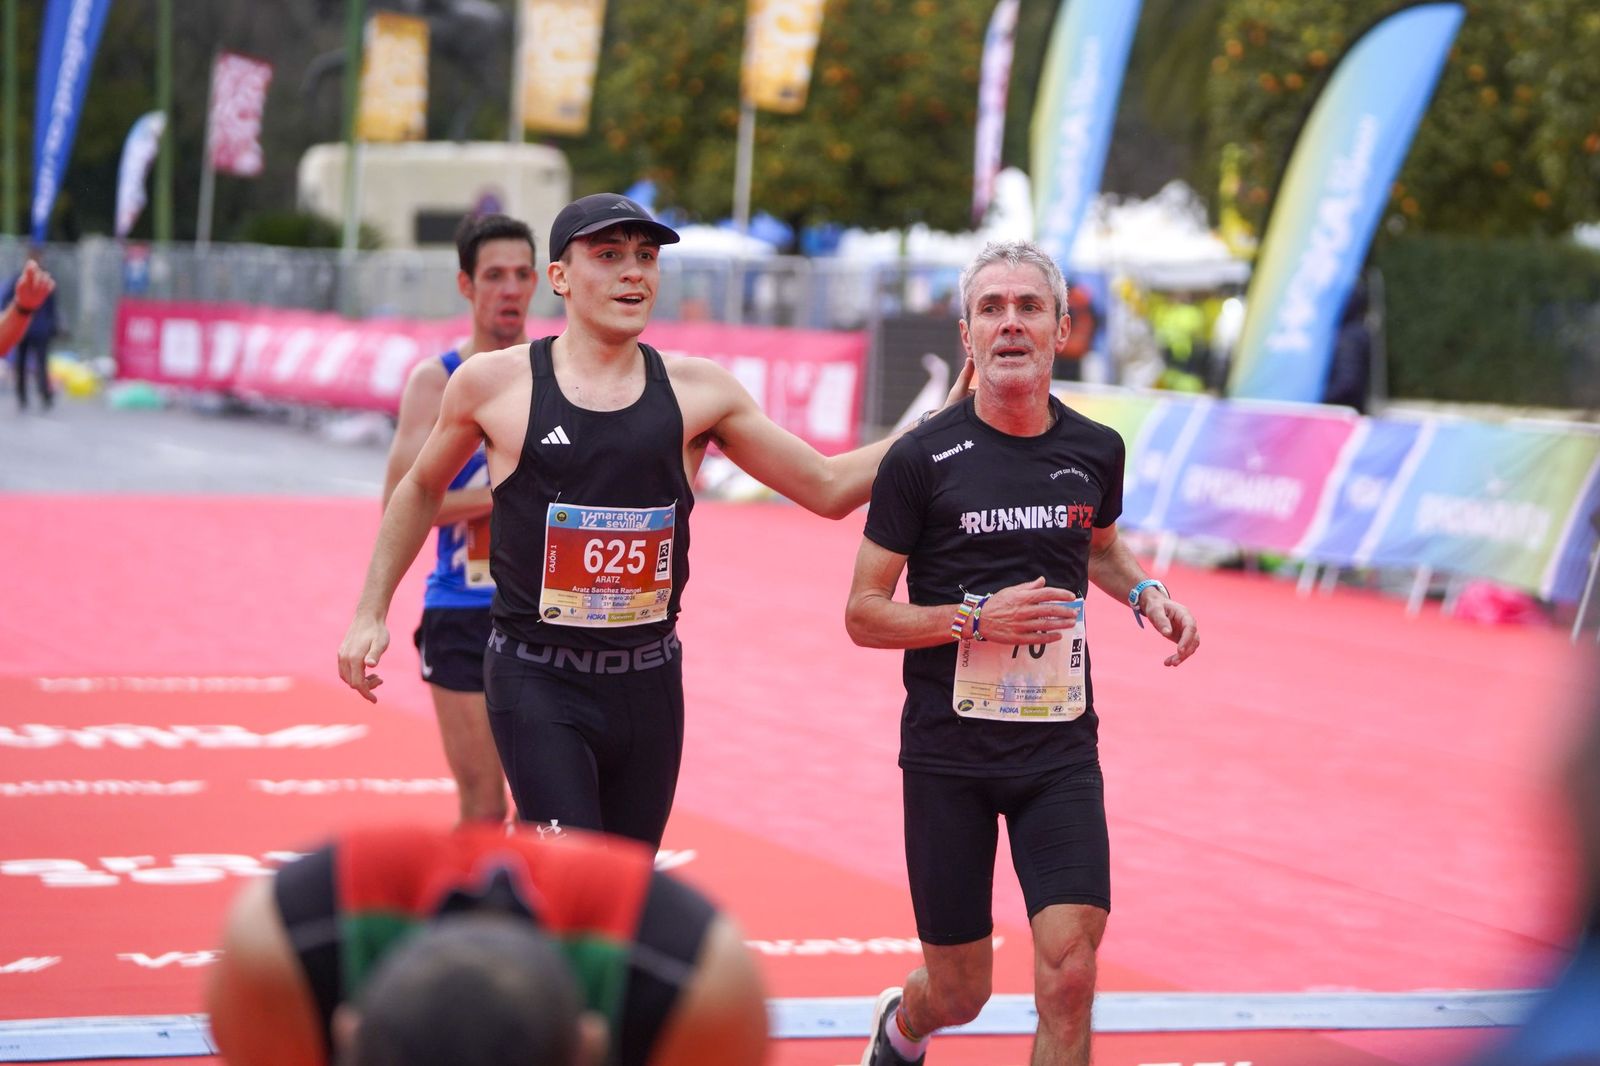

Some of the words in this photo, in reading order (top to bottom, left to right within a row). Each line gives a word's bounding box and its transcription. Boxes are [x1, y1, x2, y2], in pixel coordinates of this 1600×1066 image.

[596, 511, 643, 521] maratón
[606, 519, 643, 529] sevilla
[583, 538, 647, 574] 625
[548, 550, 557, 573] CAJÓN
[595, 575, 620, 584] ARATZ
[572, 585, 590, 593] Aratz
[620, 587, 642, 595] Rangel
[516, 632, 681, 675] UNDER
[1000, 706, 1018, 714] HOKA
